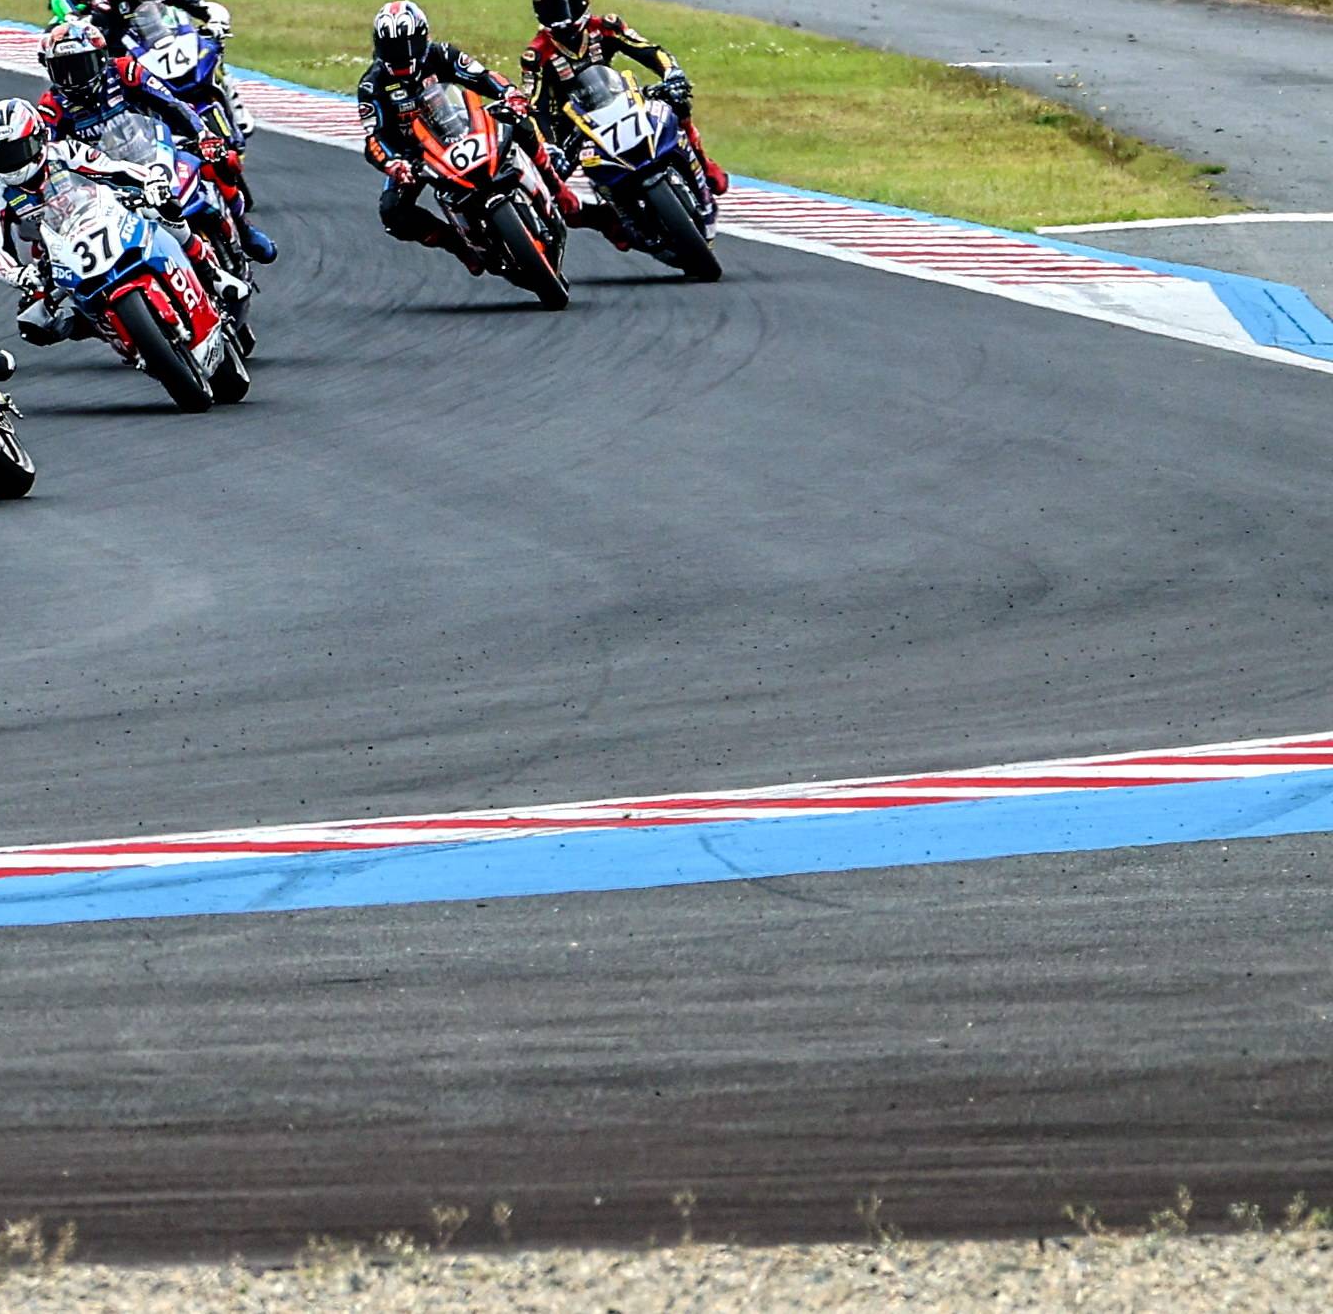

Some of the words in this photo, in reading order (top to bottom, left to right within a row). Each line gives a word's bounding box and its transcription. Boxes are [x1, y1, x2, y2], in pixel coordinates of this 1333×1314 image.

[157, 47, 190, 75] 74
[600, 113, 642, 153] 77
[450, 138, 488, 171] 62
[73, 226, 114, 274] 37
[52, 269, 73, 281] SDG
[163, 257, 199, 312] SDG
